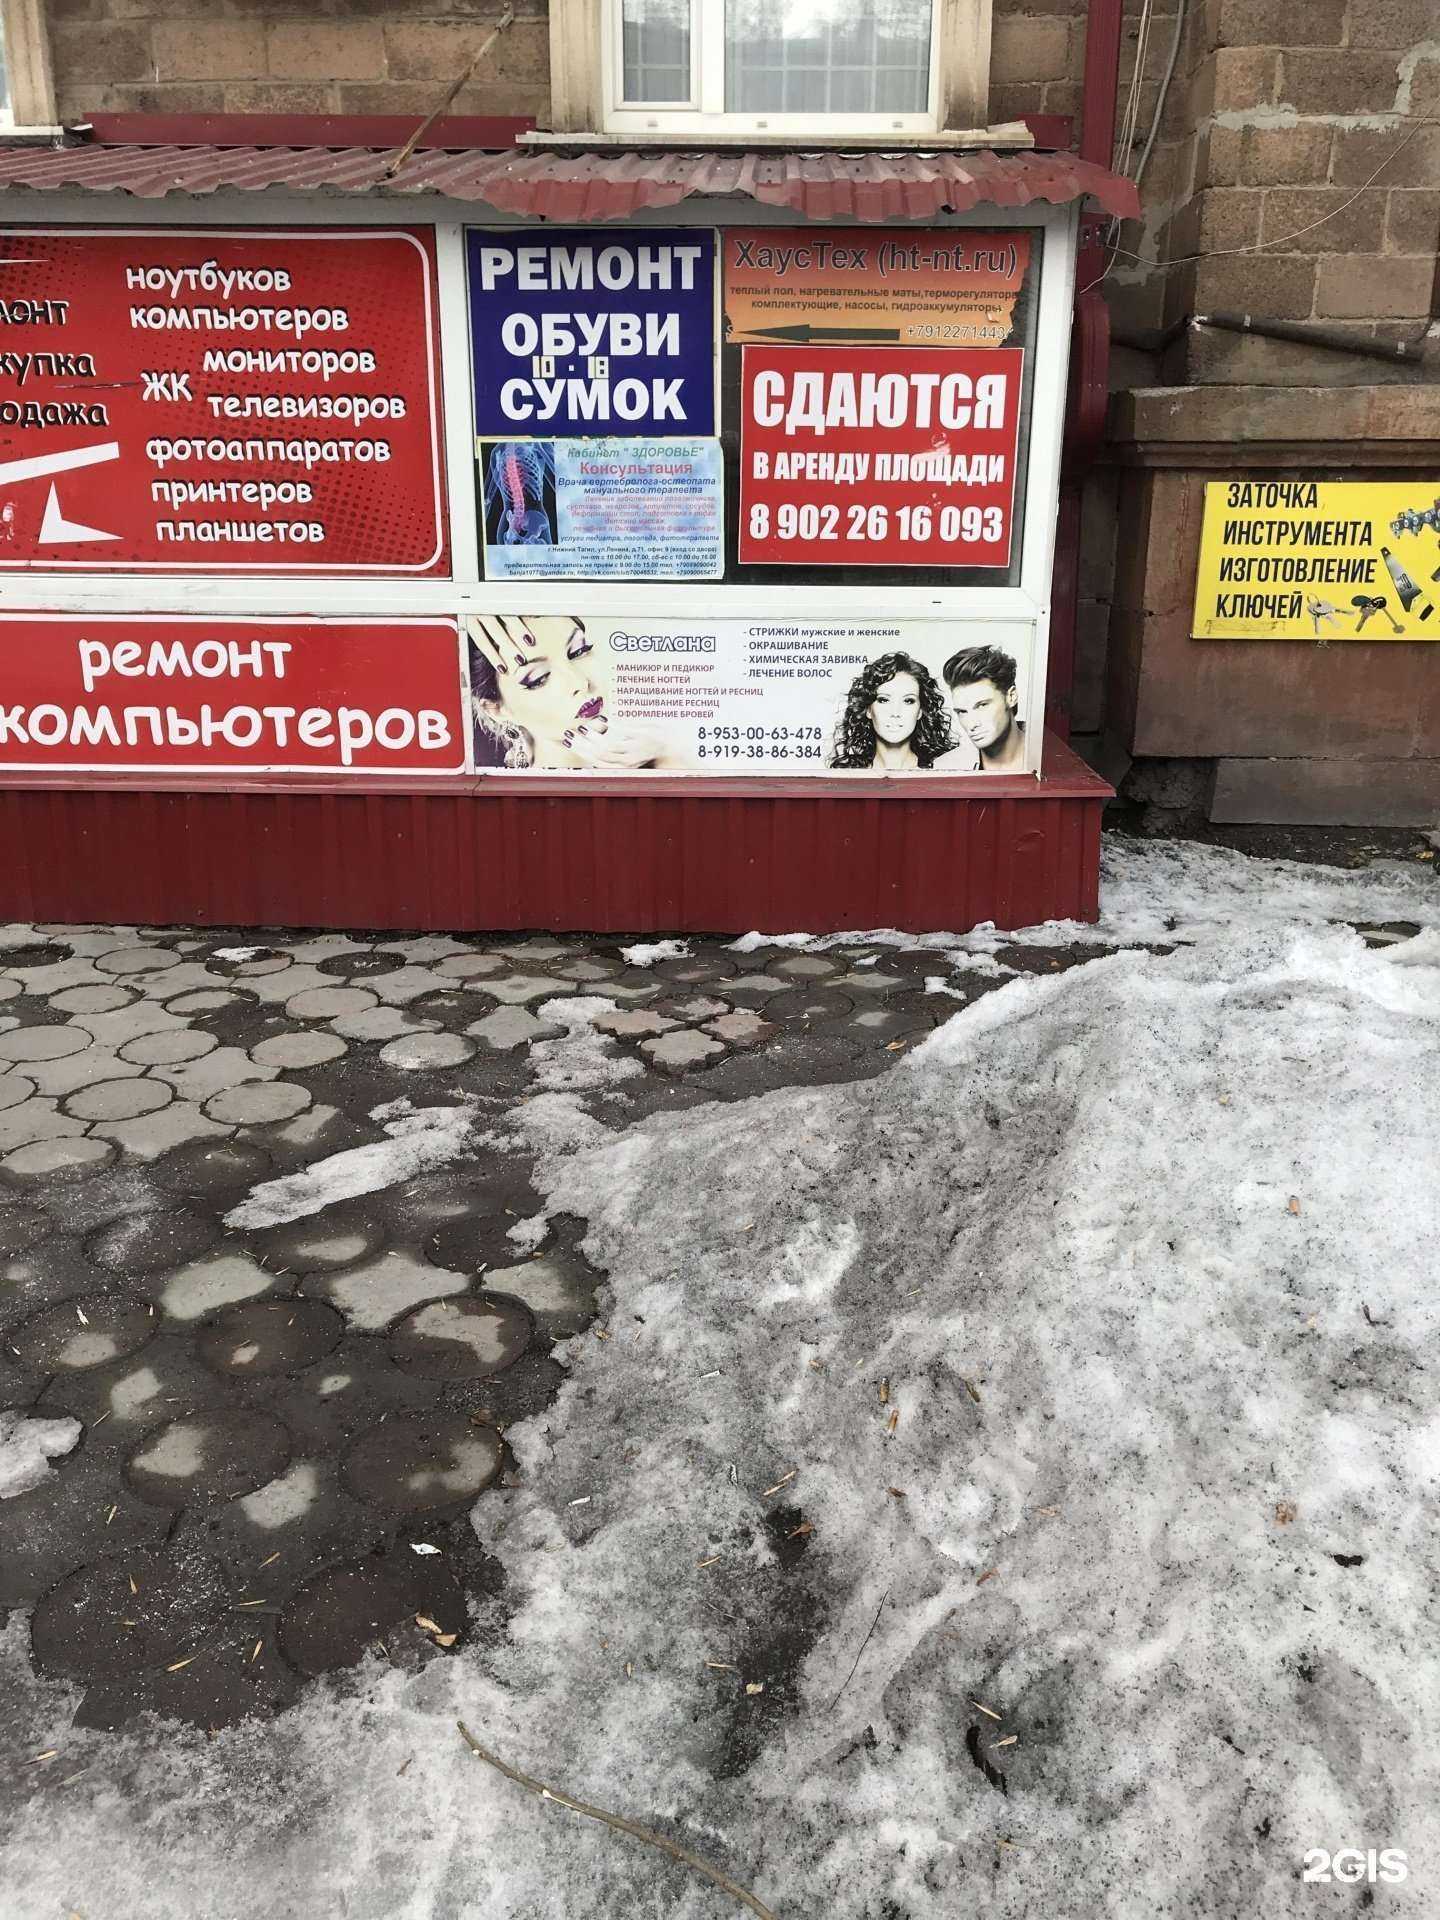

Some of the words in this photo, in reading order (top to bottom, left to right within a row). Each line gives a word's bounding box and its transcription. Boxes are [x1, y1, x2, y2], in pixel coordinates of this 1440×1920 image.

[480, 245, 702, 291] РЕМОНТ
[734, 239, 869, 277] ХаусТех
[877, 240, 1018, 281] (ht-nt.ru)
[125, 259, 292, 299] ноутбуков
[729, 286, 771, 296] теплый
[773, 287, 797, 297] пол,
[799, 287, 889, 299] нагревательные
[751, 299, 842, 311] комплектующие,
[845, 301, 888, 312] насосы,
[891, 302, 1003, 314] гидроаккумуляторы
[128, 303, 350, 340] компьютеров
[501, 312, 681, 357] ОБУВИ
[202, 347, 376, 382] мониторов
[140, 371, 193, 402] ЖК
[500, 378, 688, 421] СУМОК
[206, 394, 407, 427] телевизоров
[752, 370, 1008, 436] СДАЮТСЯ
[145, 437, 392, 469] фотоаппаратов
[558, 477, 588, 488] Врача
[580, 461, 693, 478] Консультация
[753, 452, 769, 480] В
[774, 452, 870, 485] АРЕНДУ
[874, 453, 1005, 487] ПЛОЩАДИ
[151, 478, 313, 511] принтеров
[583, 487, 647, 496] мануального
[1227, 482, 1319, 509] ЗАТОЧКА
[155, 518, 325, 544] планшетов
[749, 503, 770, 539] 8
[777, 503, 840, 540] 902
[847, 504, 888, 541] 26
[896, 505, 932, 541] 16
[939, 506, 1003, 542] 093
[1223, 520, 1373, 546] ИНСТРУМЕНТА
[1219, 557, 1378, 583] ИЗГОТОВЛЕНИЕ
[1215, 591, 1304, 619] КЛЮЧЕЙ
[609, 631, 716, 652] Светлана
[748, 627, 799, 637] СТРИЖКИ
[801, 628, 846, 638] мужские
[856, 628, 901, 637] женские
[748, 641, 829, 650] ОКРАШИВАНИЕ
[78, 638, 293, 693] ремонт
[616, 664, 662, 672] МАНИКЮР
[671, 664, 715, 673] ПЕДИКЮР
[748, 655, 819, 664] ХИМИЧЕСКАЯ
[821, 655, 868, 664] ЗАВИВКА
[616, 675, 656, 684] ЛЕЧЕНИЕ
[657, 674, 691, 684] НОГТЕЙ
[748, 669, 795, 678] ЛЕЧЕНИЕ
[797, 669, 833, 678] ВОЛОС
[616, 687, 684, 696] НАРАЩИВАНИЕ
[685, 686, 719, 696] НОГТЕЙ
[720, 688, 727, 696] И
[728, 688, 764, 697] РЕСНИЦ
[617, 698, 684, 707] ОКРАШИВАНИЕ
[685, 699, 720, 708] РЕСНИЦ
[617, 710, 679, 718] ОФОРМЛЕНИЕ
[680, 709, 714, 718] БРОВЕЙ
[0, 704, 452, 765] компьютеров
[697, 726, 822, 740] 8-953-00-63-478
[697, 745, 822, 758] 8-919-38-86-384
